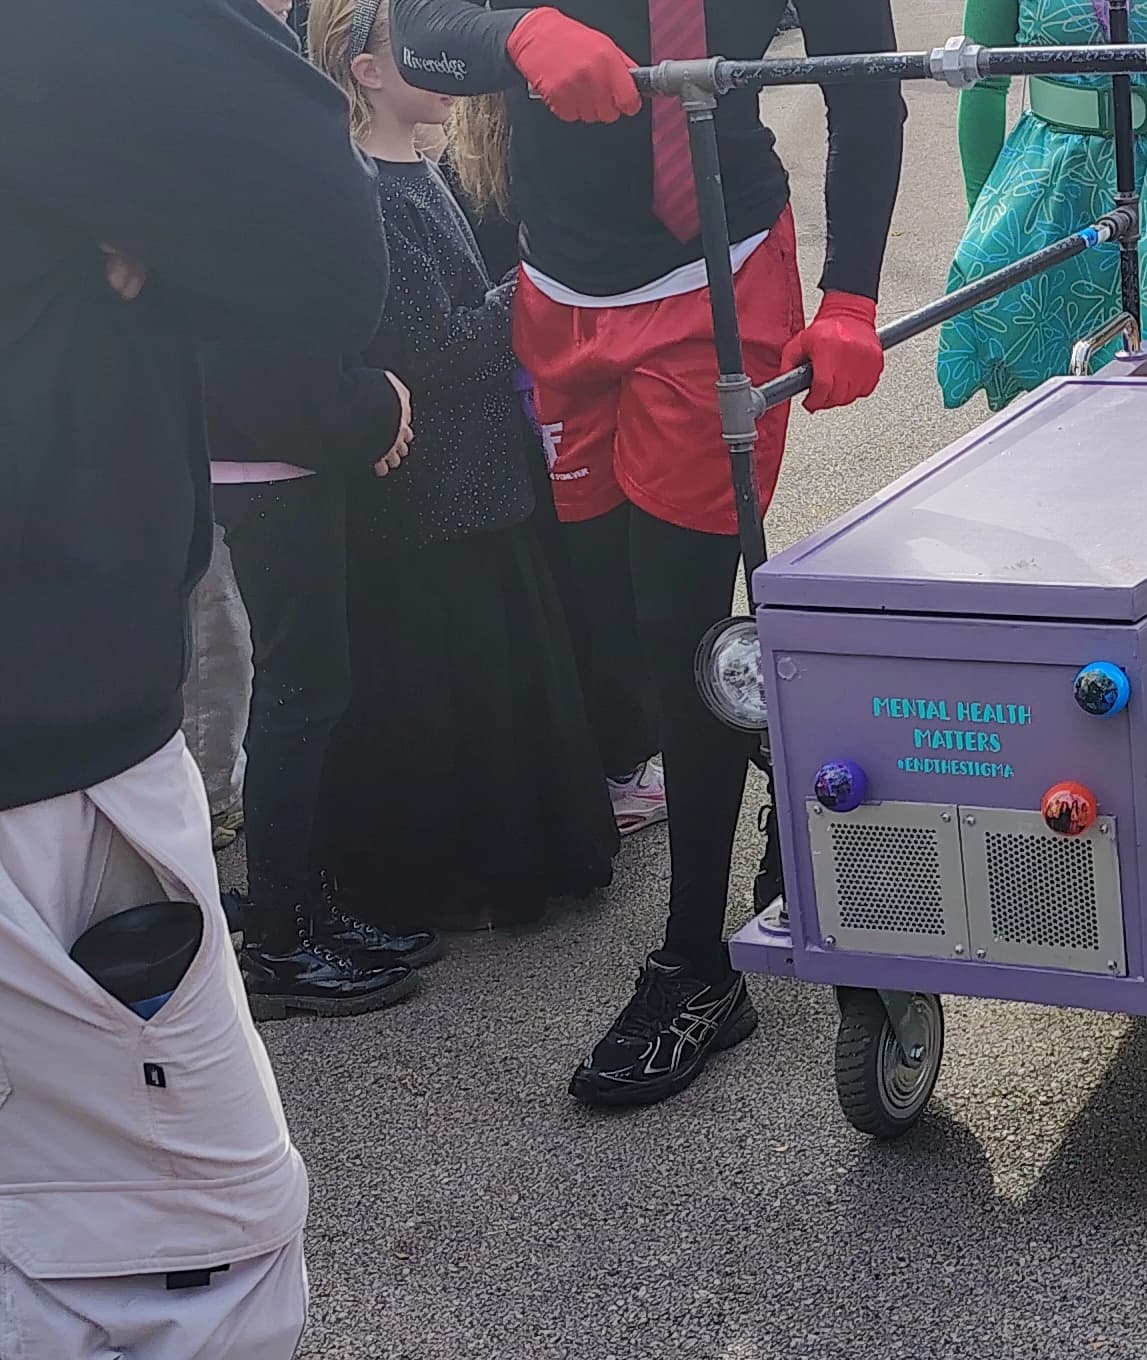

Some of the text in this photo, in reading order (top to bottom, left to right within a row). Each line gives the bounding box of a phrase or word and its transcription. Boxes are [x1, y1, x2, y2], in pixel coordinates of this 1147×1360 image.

[403, 46, 468, 81] Riveredge
[872, 697, 1033, 725] MENTAL HEALTH
[913, 728, 1001, 753] MATTERS
